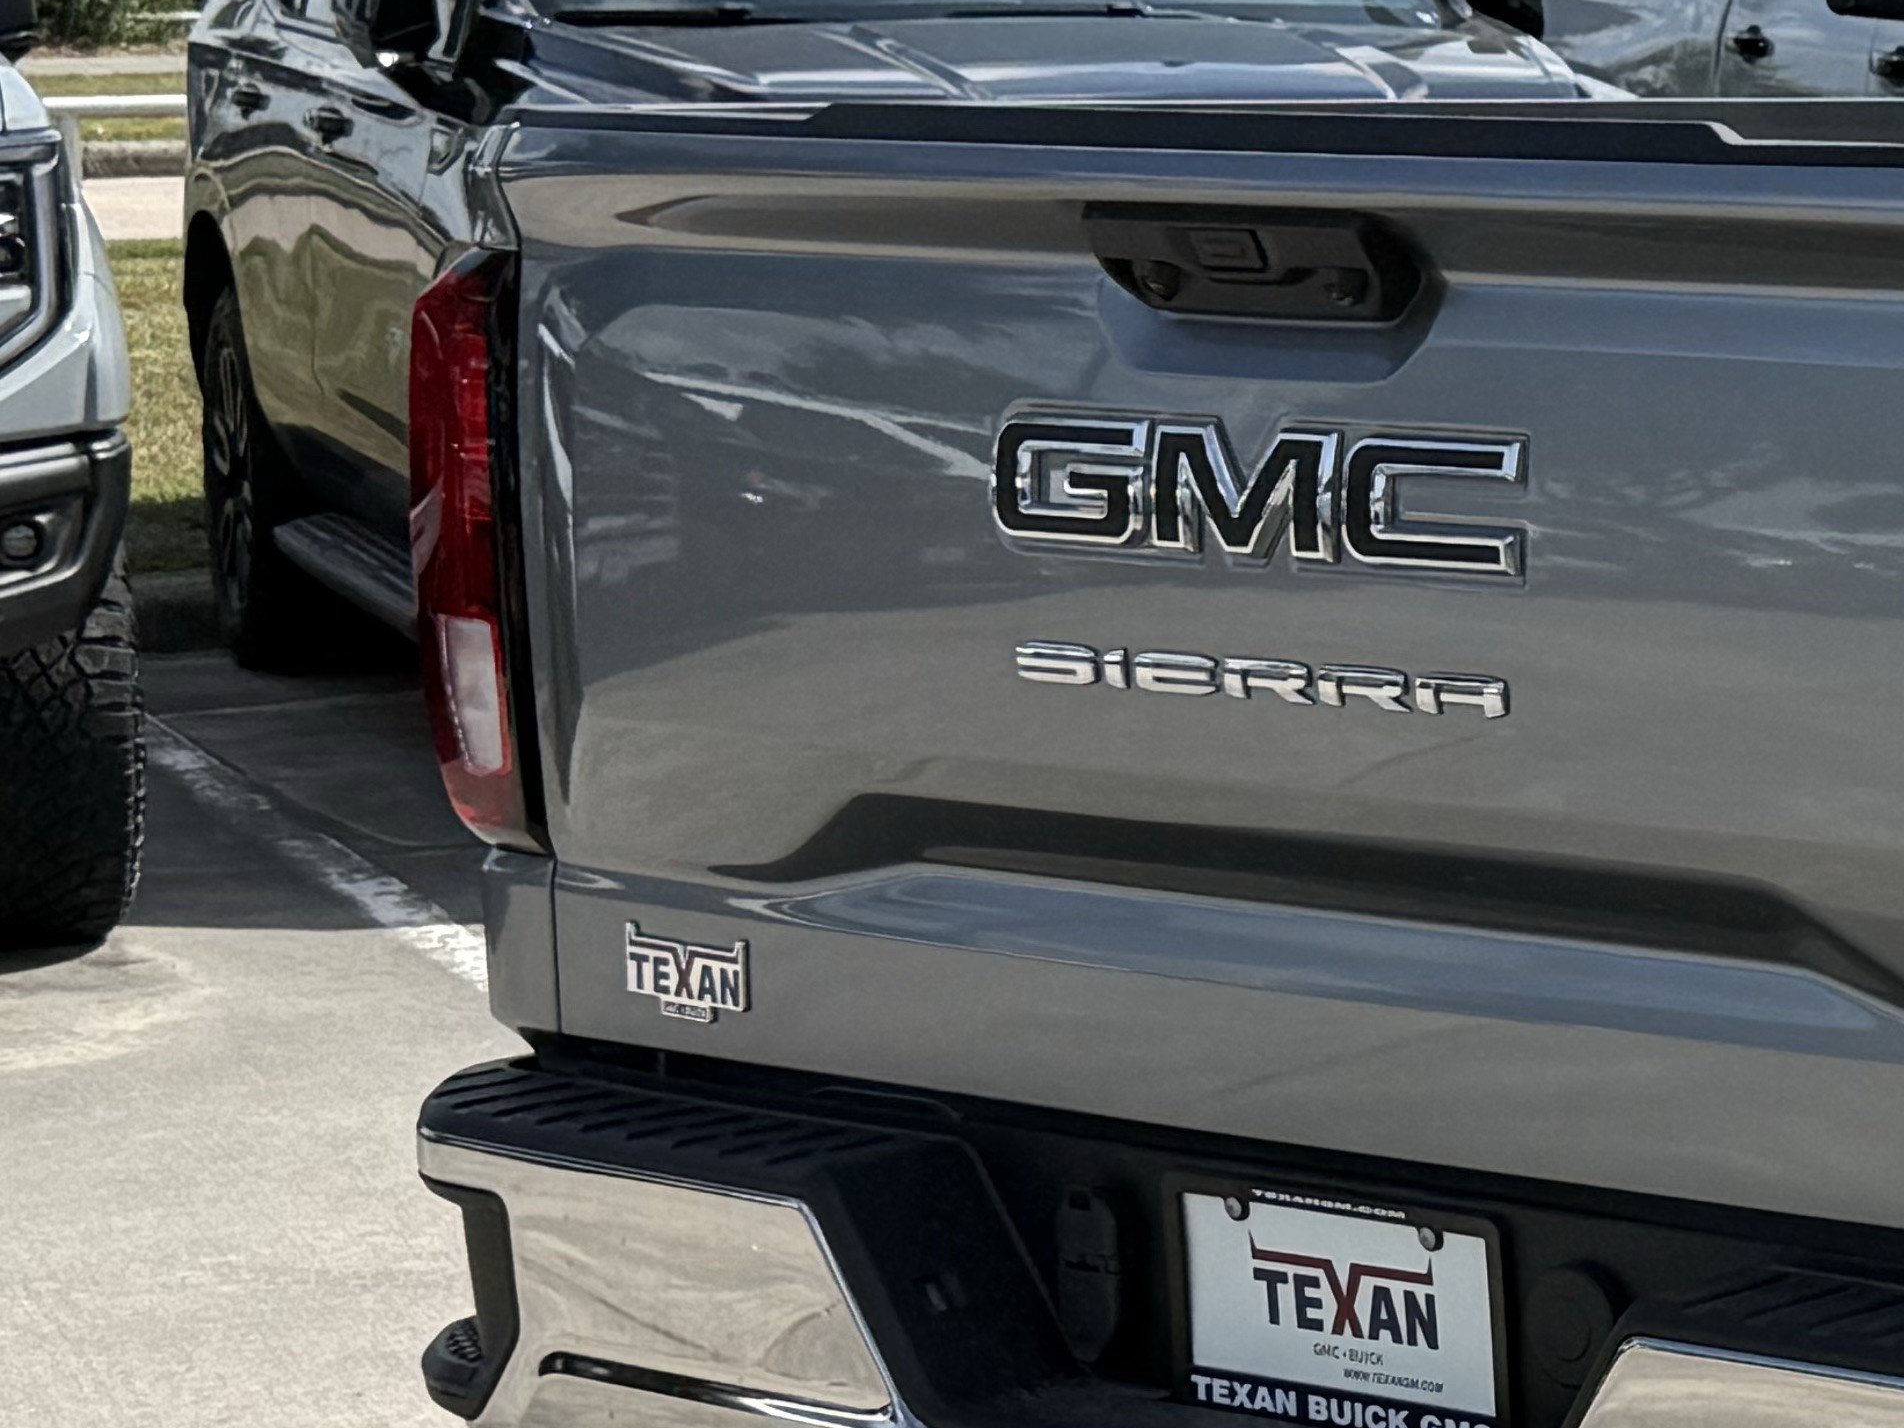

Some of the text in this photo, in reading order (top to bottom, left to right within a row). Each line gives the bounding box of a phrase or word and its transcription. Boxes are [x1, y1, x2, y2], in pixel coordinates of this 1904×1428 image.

[991, 410, 1530, 580] GMC
[1015, 640, 1510, 719] SIERRA
[628, 938, 740, 1008] TEXAN
[1249, 1244, 1440, 1351] TEXAN
[1190, 1374, 1298, 1417] TEXAN
